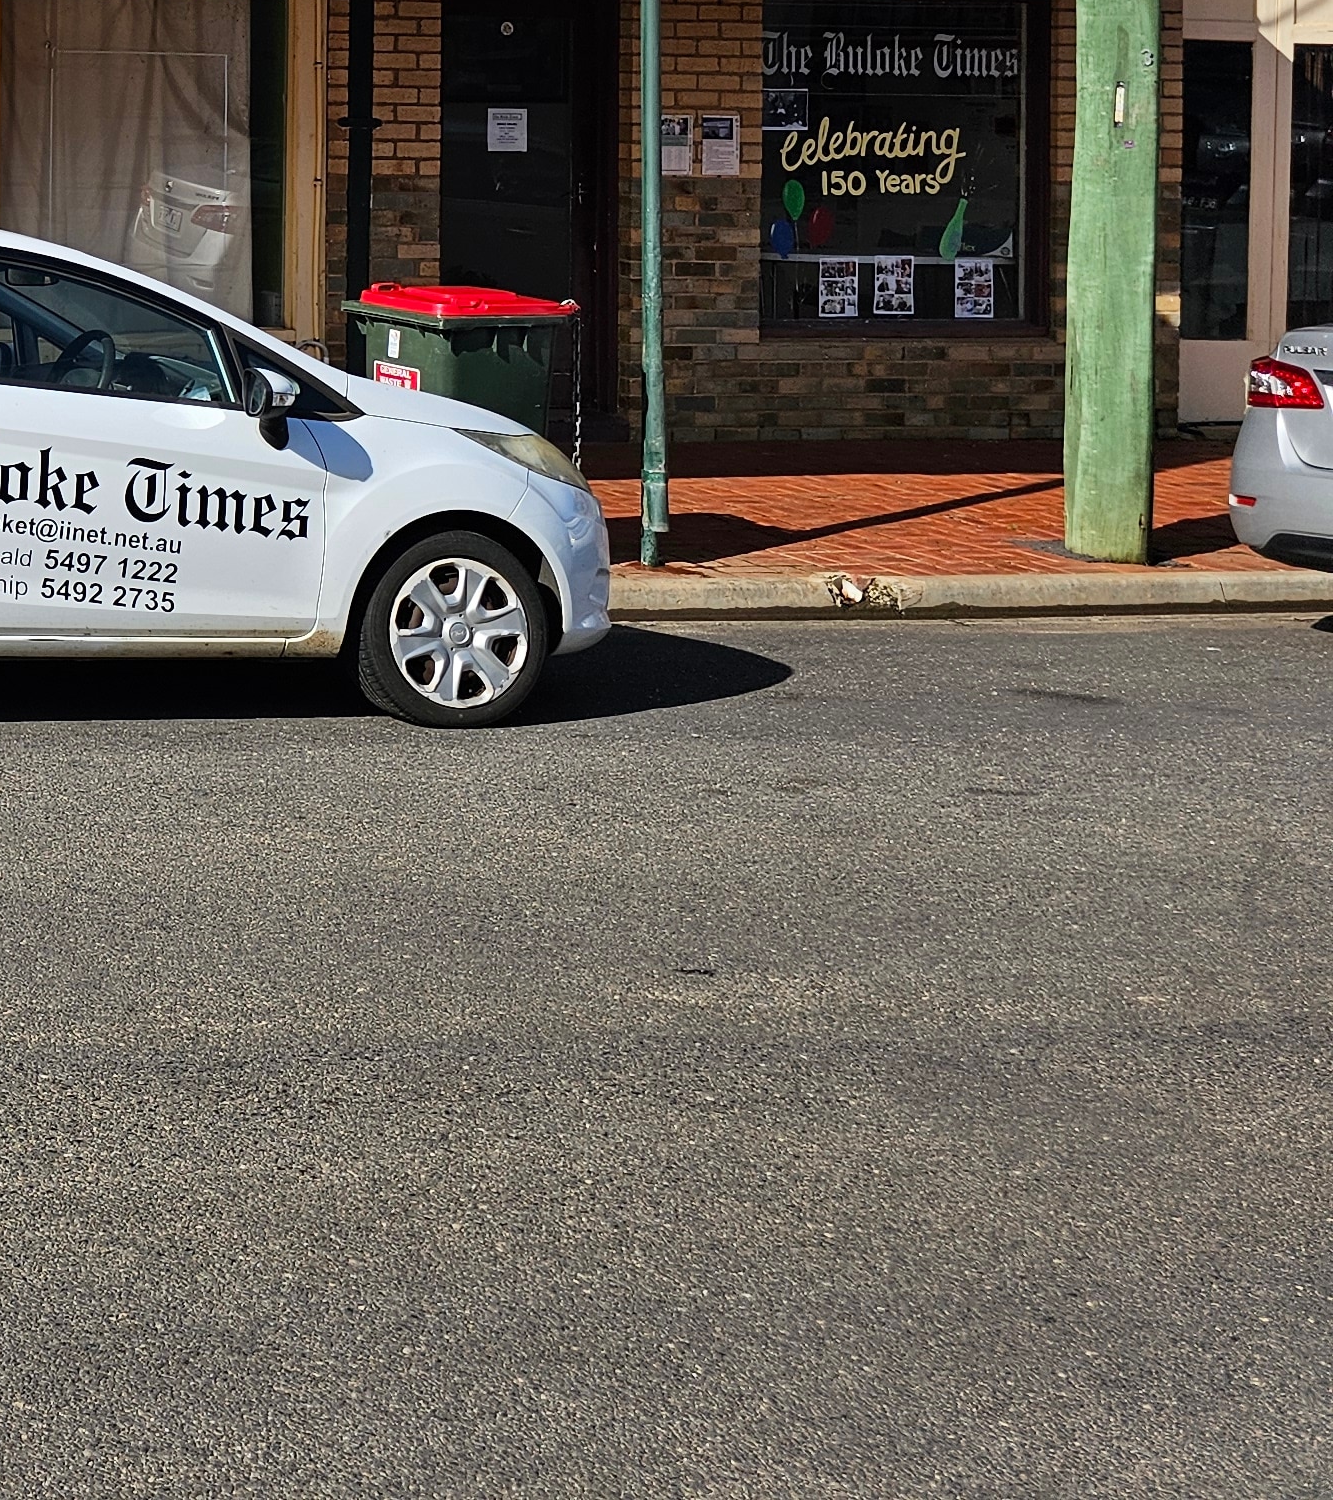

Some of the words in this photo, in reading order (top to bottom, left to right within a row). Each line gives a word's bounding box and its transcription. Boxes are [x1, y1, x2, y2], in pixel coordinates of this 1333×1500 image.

[762, 32, 813, 86] The
[821, 32, 924, 90] Buloke
[934, 33, 1019, 79] Times
[780, 116, 967, 184] Celebrating
[821, 170, 867, 197] 150
[875, 169, 941, 195] Years
[1283, 345, 1328, 357] PULSAR
[379, 365, 412, 380] GENERAL
[124, 457, 312, 542] Times
[43, 548, 108, 576] 5497
[117, 556, 179, 584] 1222
[39, 577, 103, 605] 5492
[112, 584, 175, 613] 2735
